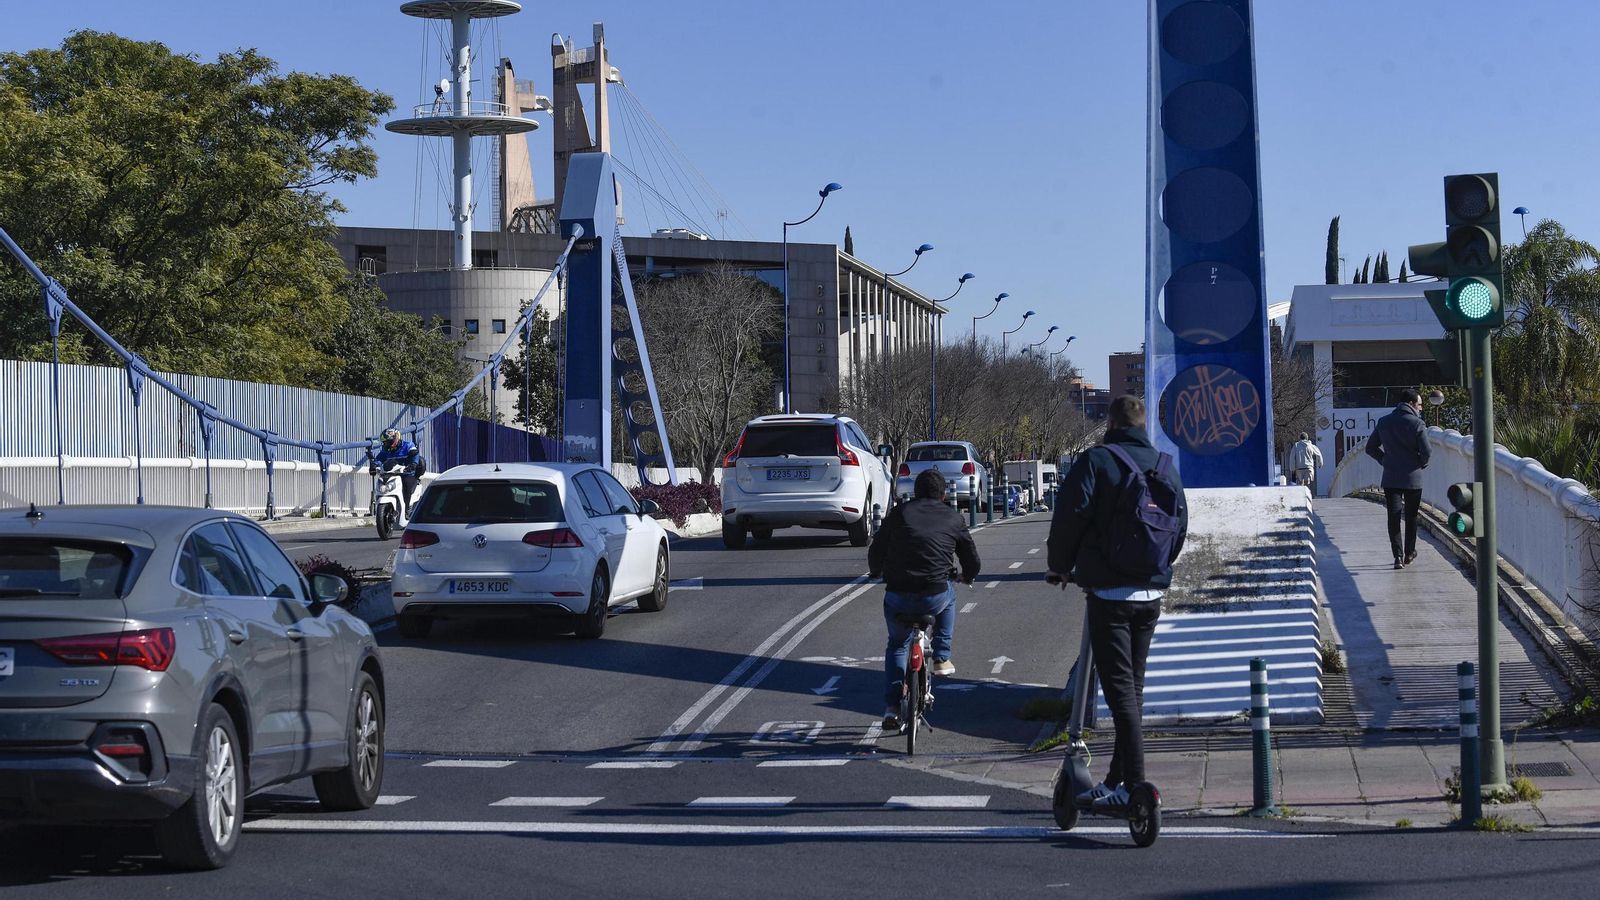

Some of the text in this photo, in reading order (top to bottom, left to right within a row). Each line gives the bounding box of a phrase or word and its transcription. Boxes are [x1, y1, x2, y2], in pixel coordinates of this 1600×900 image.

[772, 470, 808, 478] 2235 JXS
[457, 581, 509, 593] 4653 KDC
